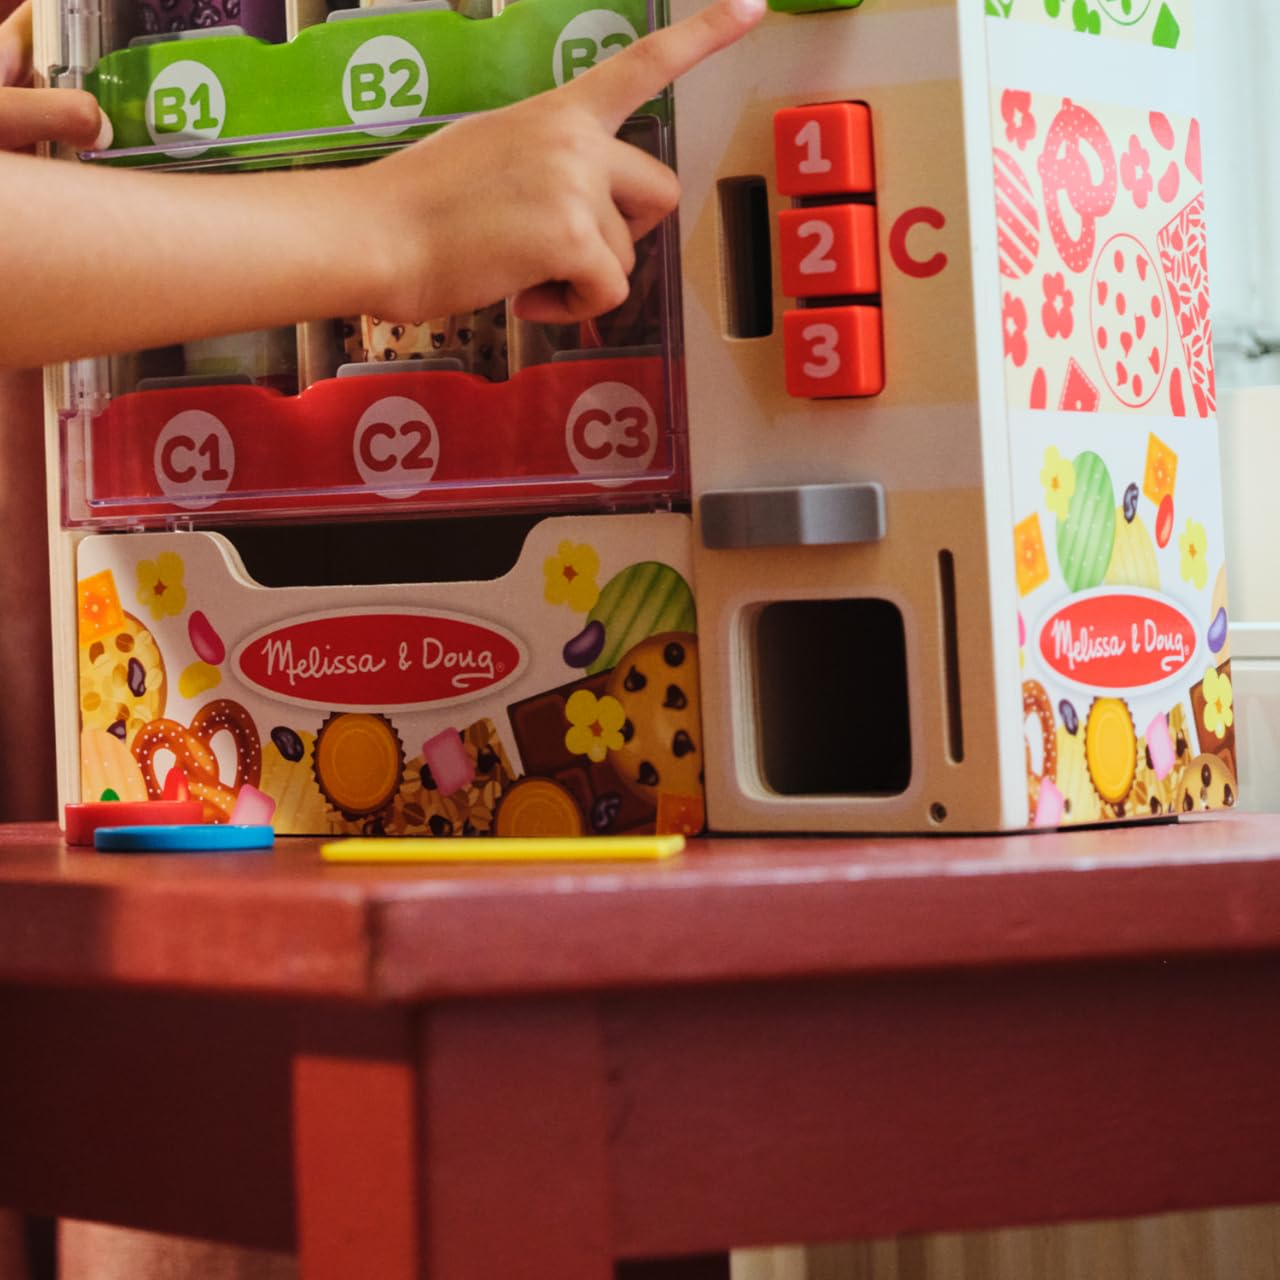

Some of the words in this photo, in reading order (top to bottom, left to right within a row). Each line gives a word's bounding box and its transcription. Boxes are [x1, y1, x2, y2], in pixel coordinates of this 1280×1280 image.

[153, 81, 219, 135] B1
[349, 58, 422, 112] B2
[794, 119, 832, 175] 1
[796, 220, 837, 275] 2
[889, 206, 948, 279] C
[803, 324, 841, 379] 3
[161, 433, 229, 484] C1
[359, 419, 434, 473] C2
[572, 406, 651, 461] C3
[261, 637, 387, 686] Melissa
[398, 641, 413, 671] &
[422, 636, 495, 688] Doug
[1051, 618, 1126, 670] Melissa
